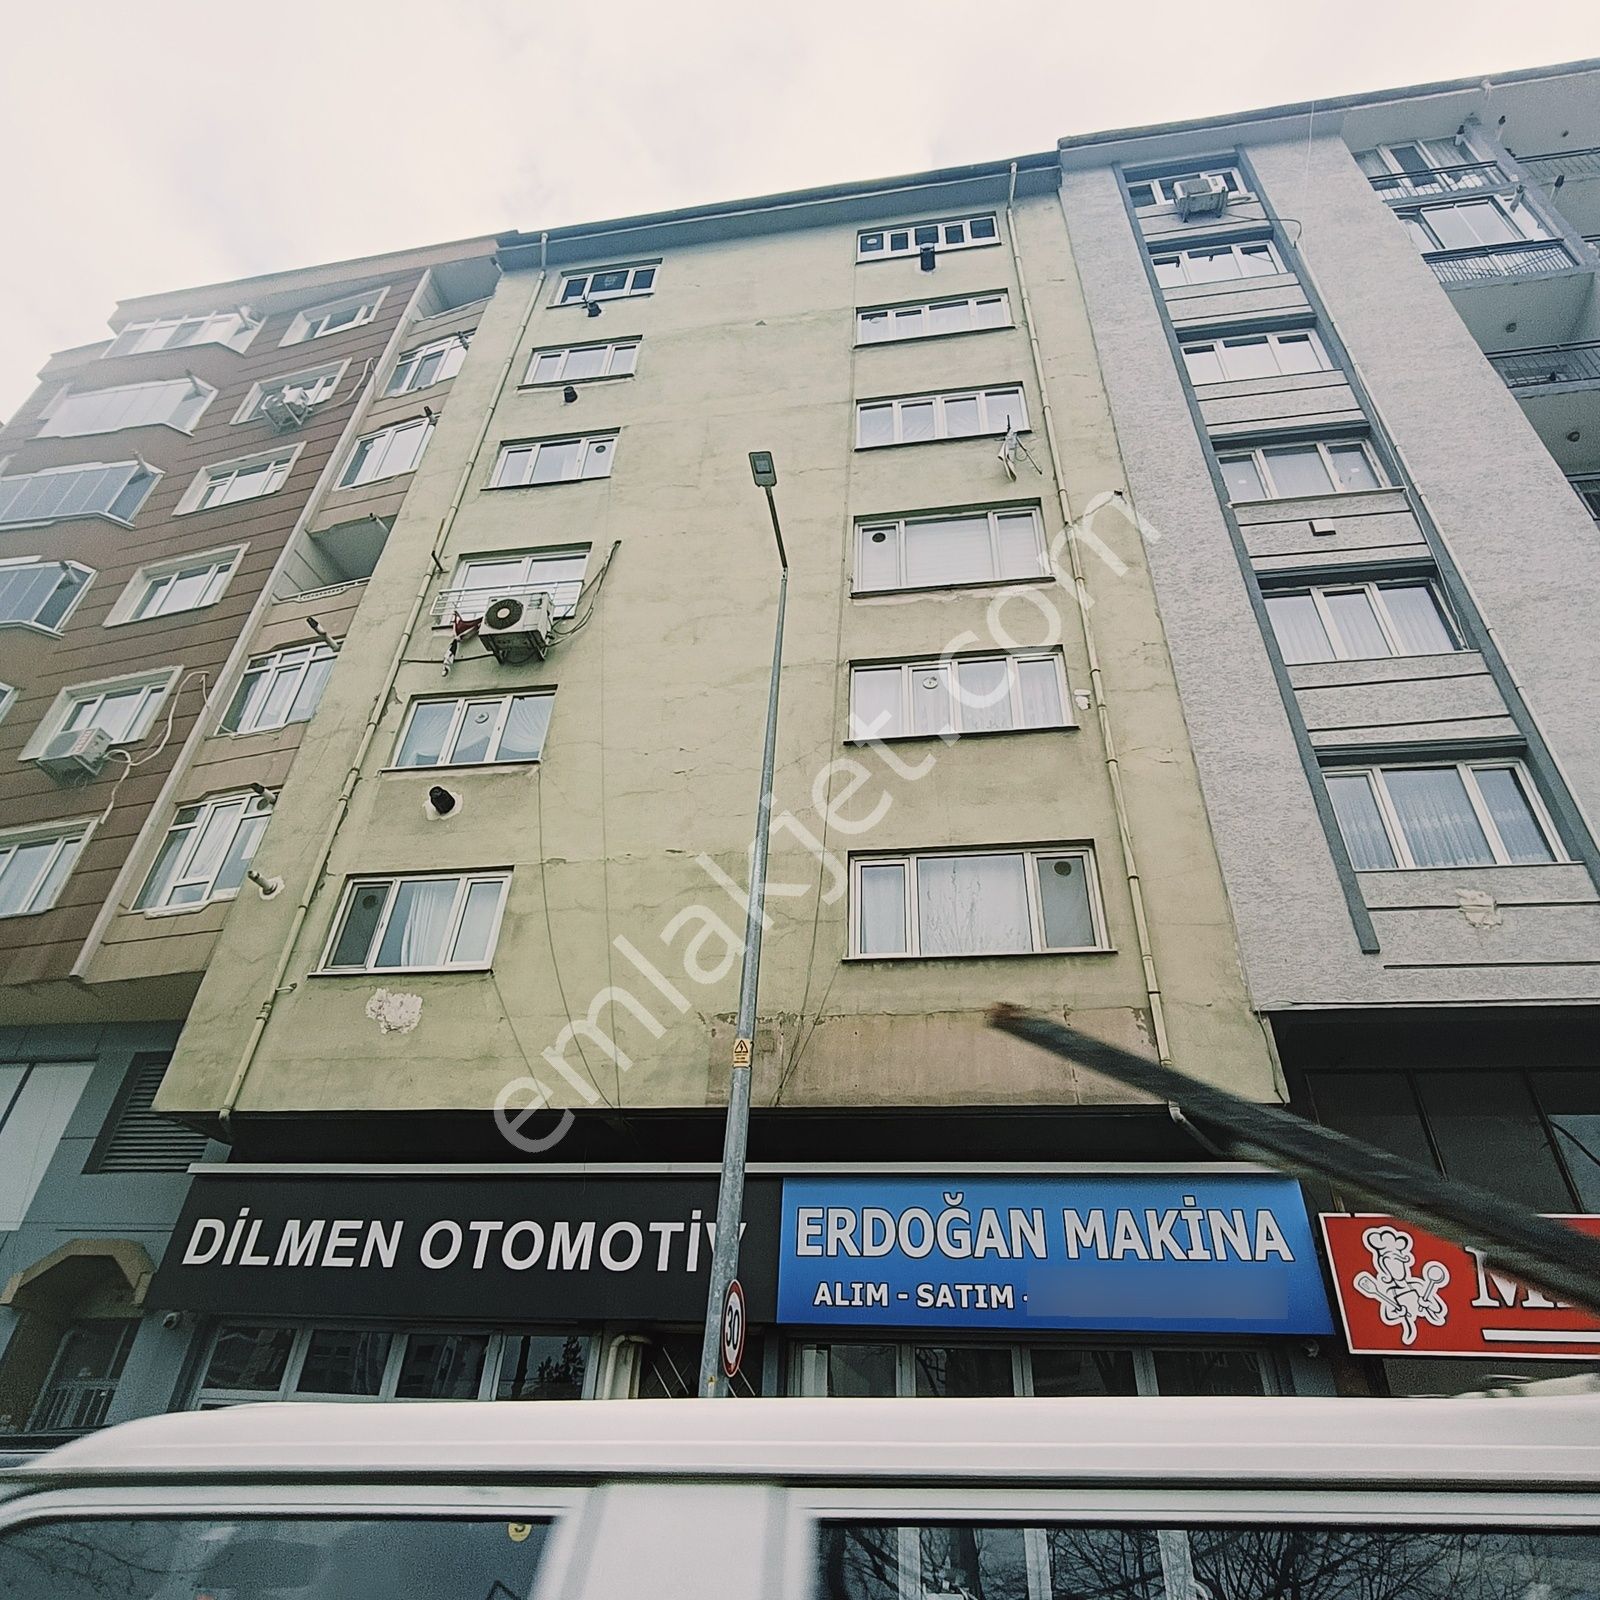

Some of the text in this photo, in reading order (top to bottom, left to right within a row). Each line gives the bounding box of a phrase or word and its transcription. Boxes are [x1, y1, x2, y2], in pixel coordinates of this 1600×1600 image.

[181, 1207, 747, 1272] DİLMEN OTOMOTİ
[796, 1192, 1295, 1262] ERDOĞAN MAKİNA
[813, 1282, 888, 1307] ALIM
[916, 1282, 1014, 1309] SATIM
[726, 1305, 740, 1350] 30
